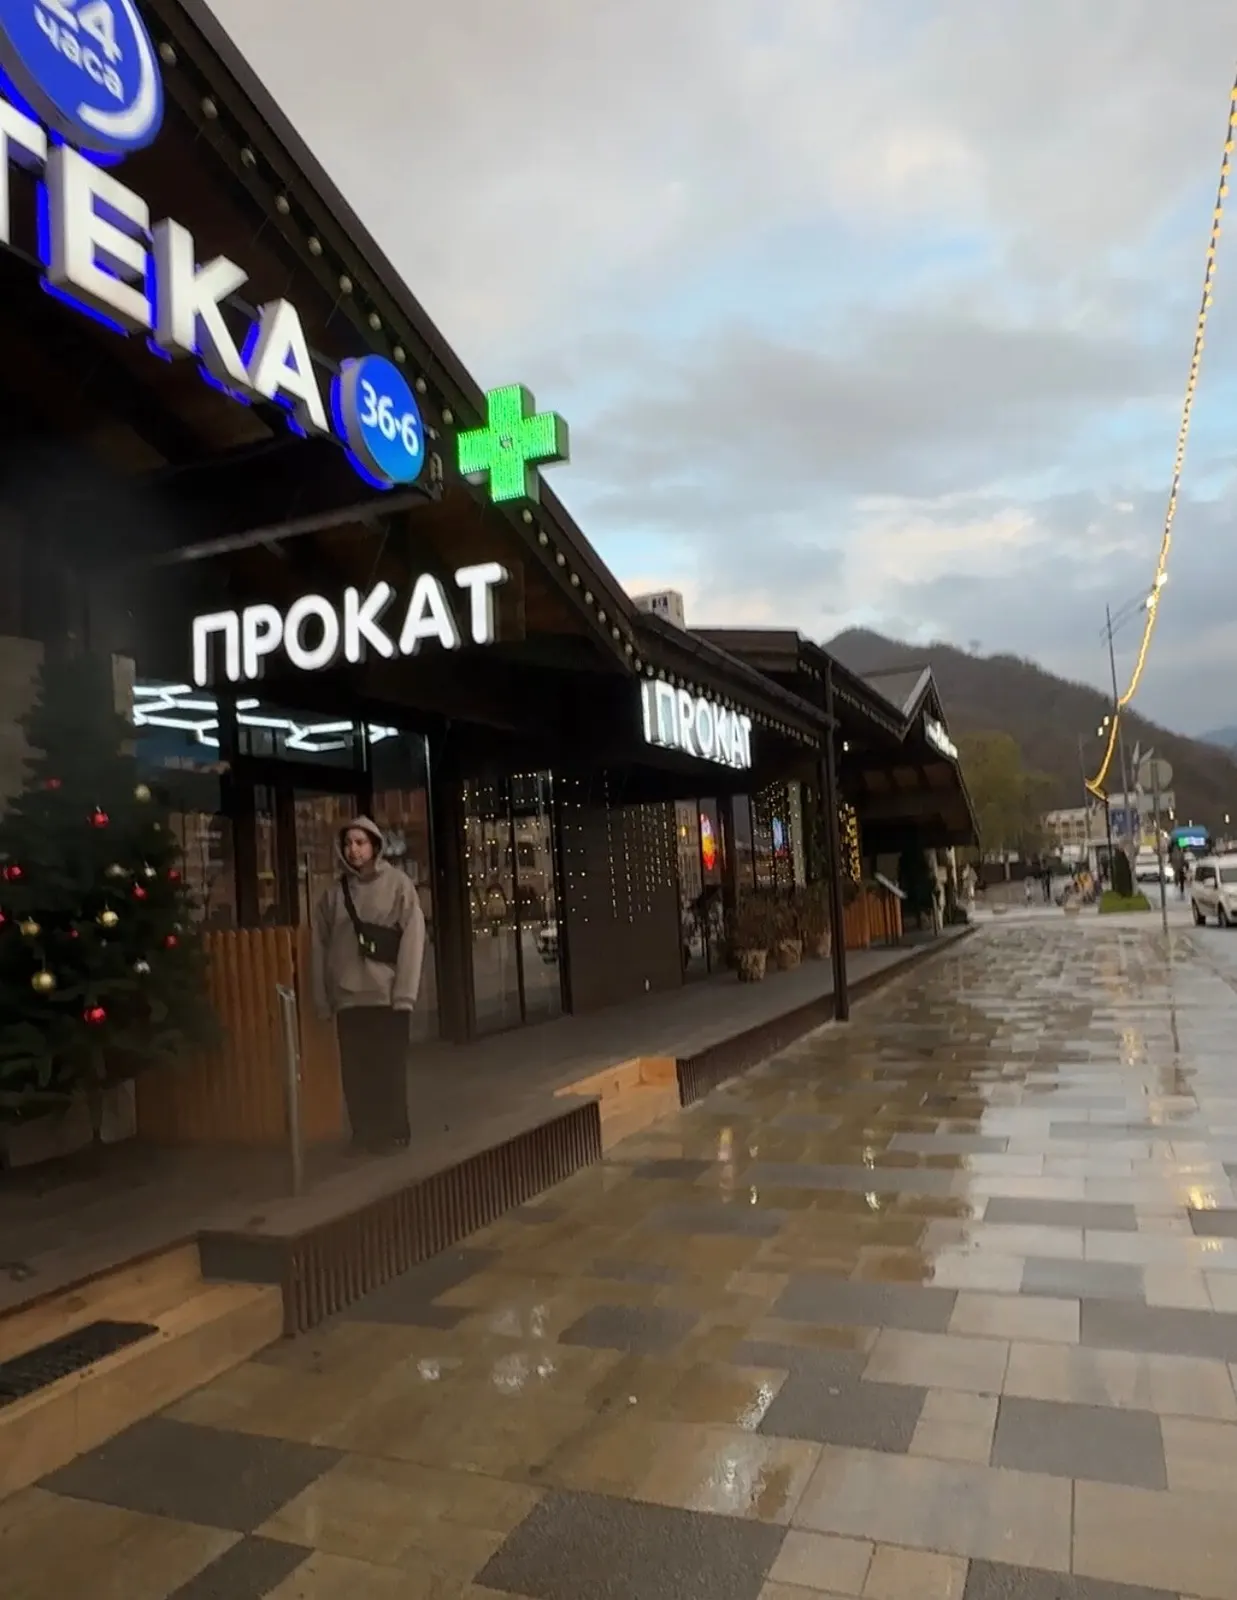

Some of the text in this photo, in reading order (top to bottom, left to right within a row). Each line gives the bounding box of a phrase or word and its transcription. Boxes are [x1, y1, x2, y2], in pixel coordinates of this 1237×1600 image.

[33, 3, 125, 104] часа
[192, 561, 507, 687] ПРОКАТ
[641, 679, 752, 769] ПРОКАТ
